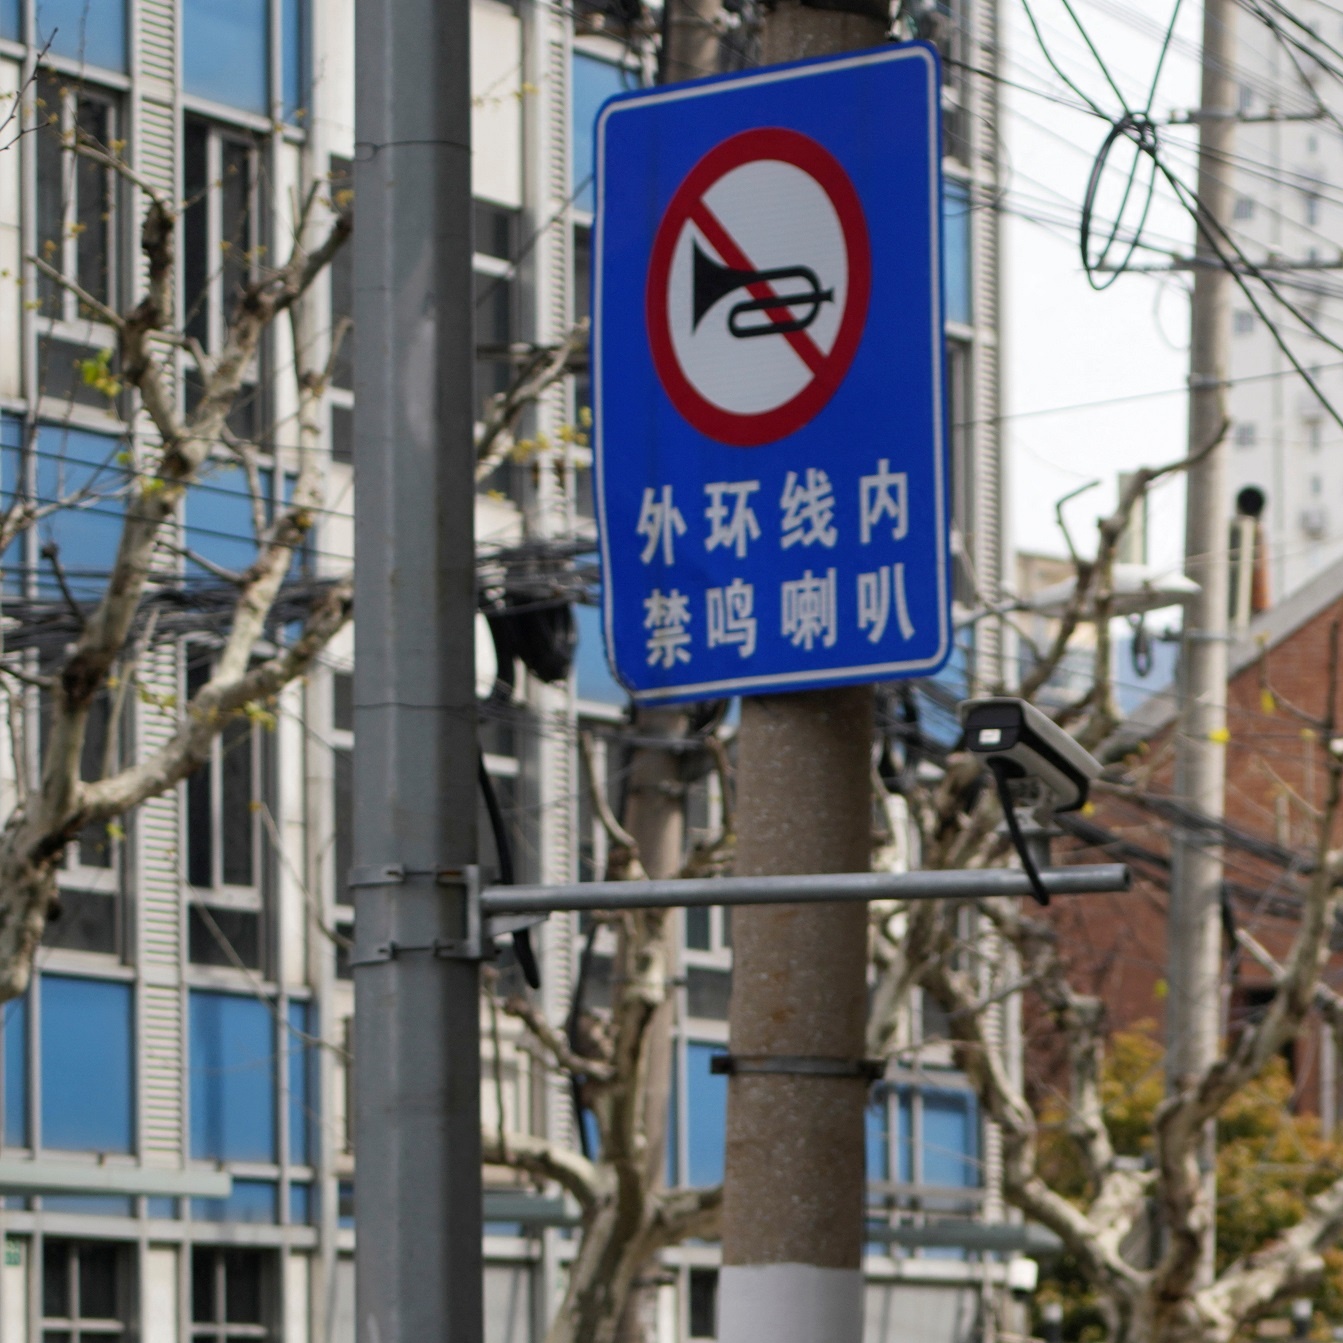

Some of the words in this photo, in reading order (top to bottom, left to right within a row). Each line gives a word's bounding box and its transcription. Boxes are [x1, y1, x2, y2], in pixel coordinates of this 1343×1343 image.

[636, 458, 909, 566] 外环线内
[642, 562, 916, 670] 禁鸣喇叭
